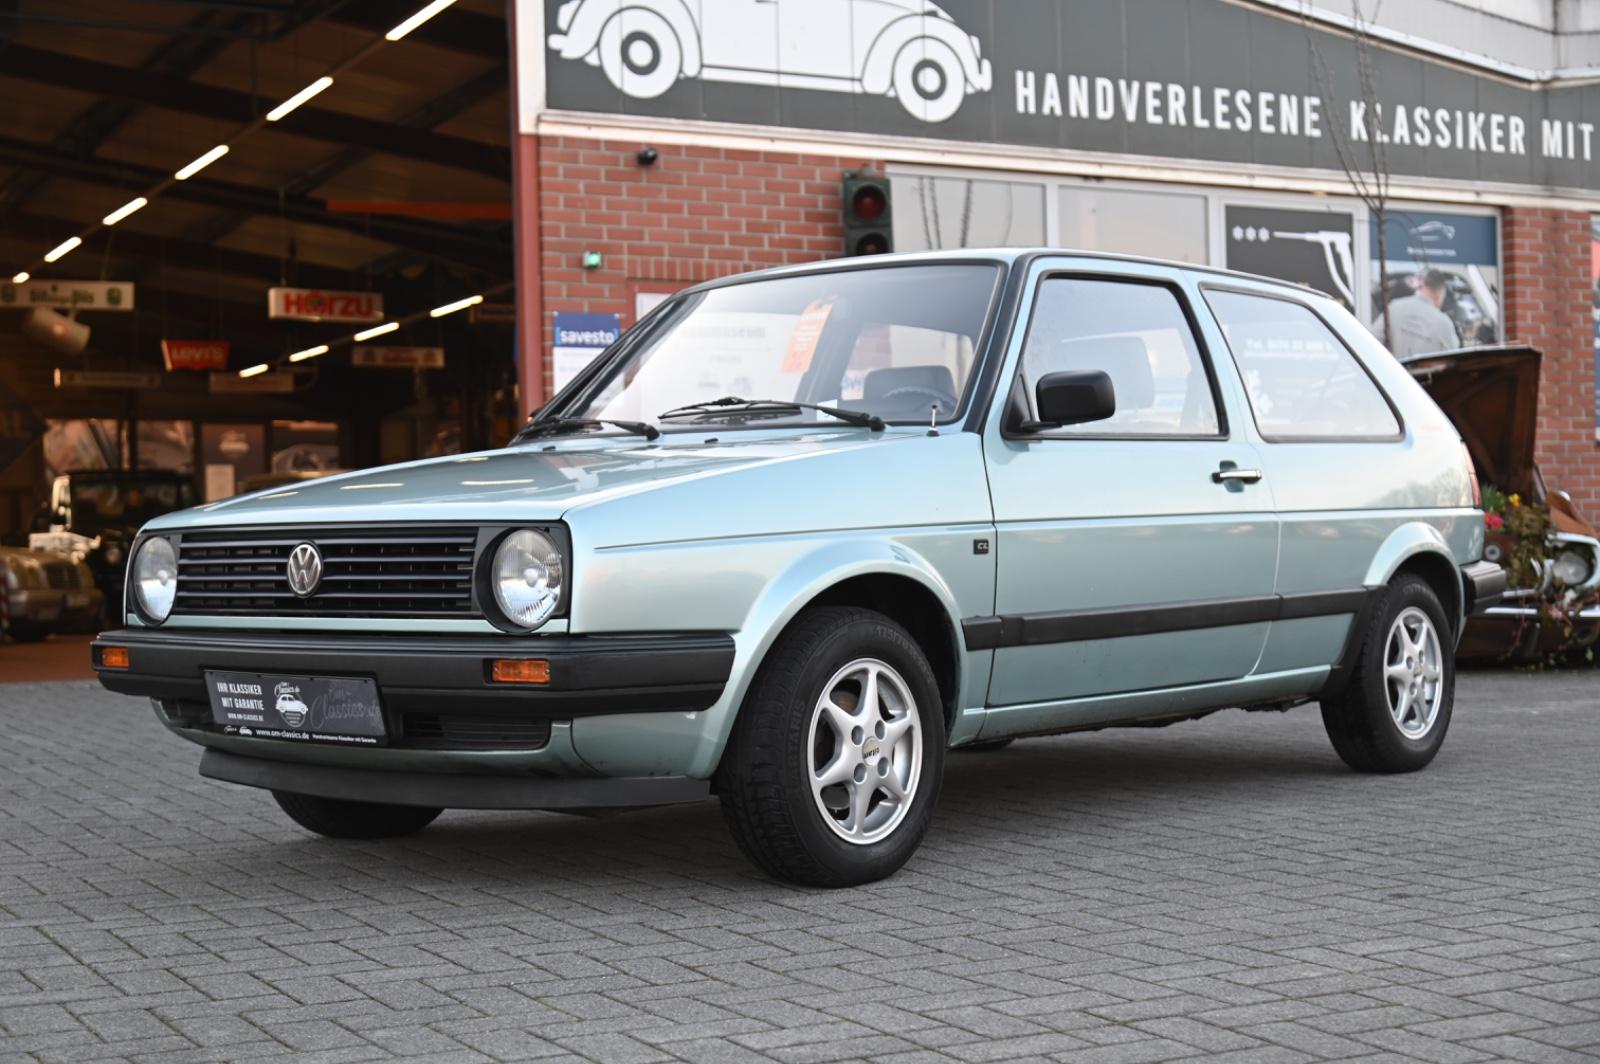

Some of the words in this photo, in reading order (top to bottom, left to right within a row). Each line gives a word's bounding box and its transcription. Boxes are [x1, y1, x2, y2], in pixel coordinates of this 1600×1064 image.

[1015, 70, 1322, 138] HANDVERLESENE
[1350, 100, 1525, 155] KLASSIKER
[1542, 118, 1594, 161] MIT
[560, 330, 615, 345] savesto
[229, 683, 262, 695] KLASSIKER
[221, 697, 233, 708] MIT
[234, 698, 264, 710] GARANTIE
